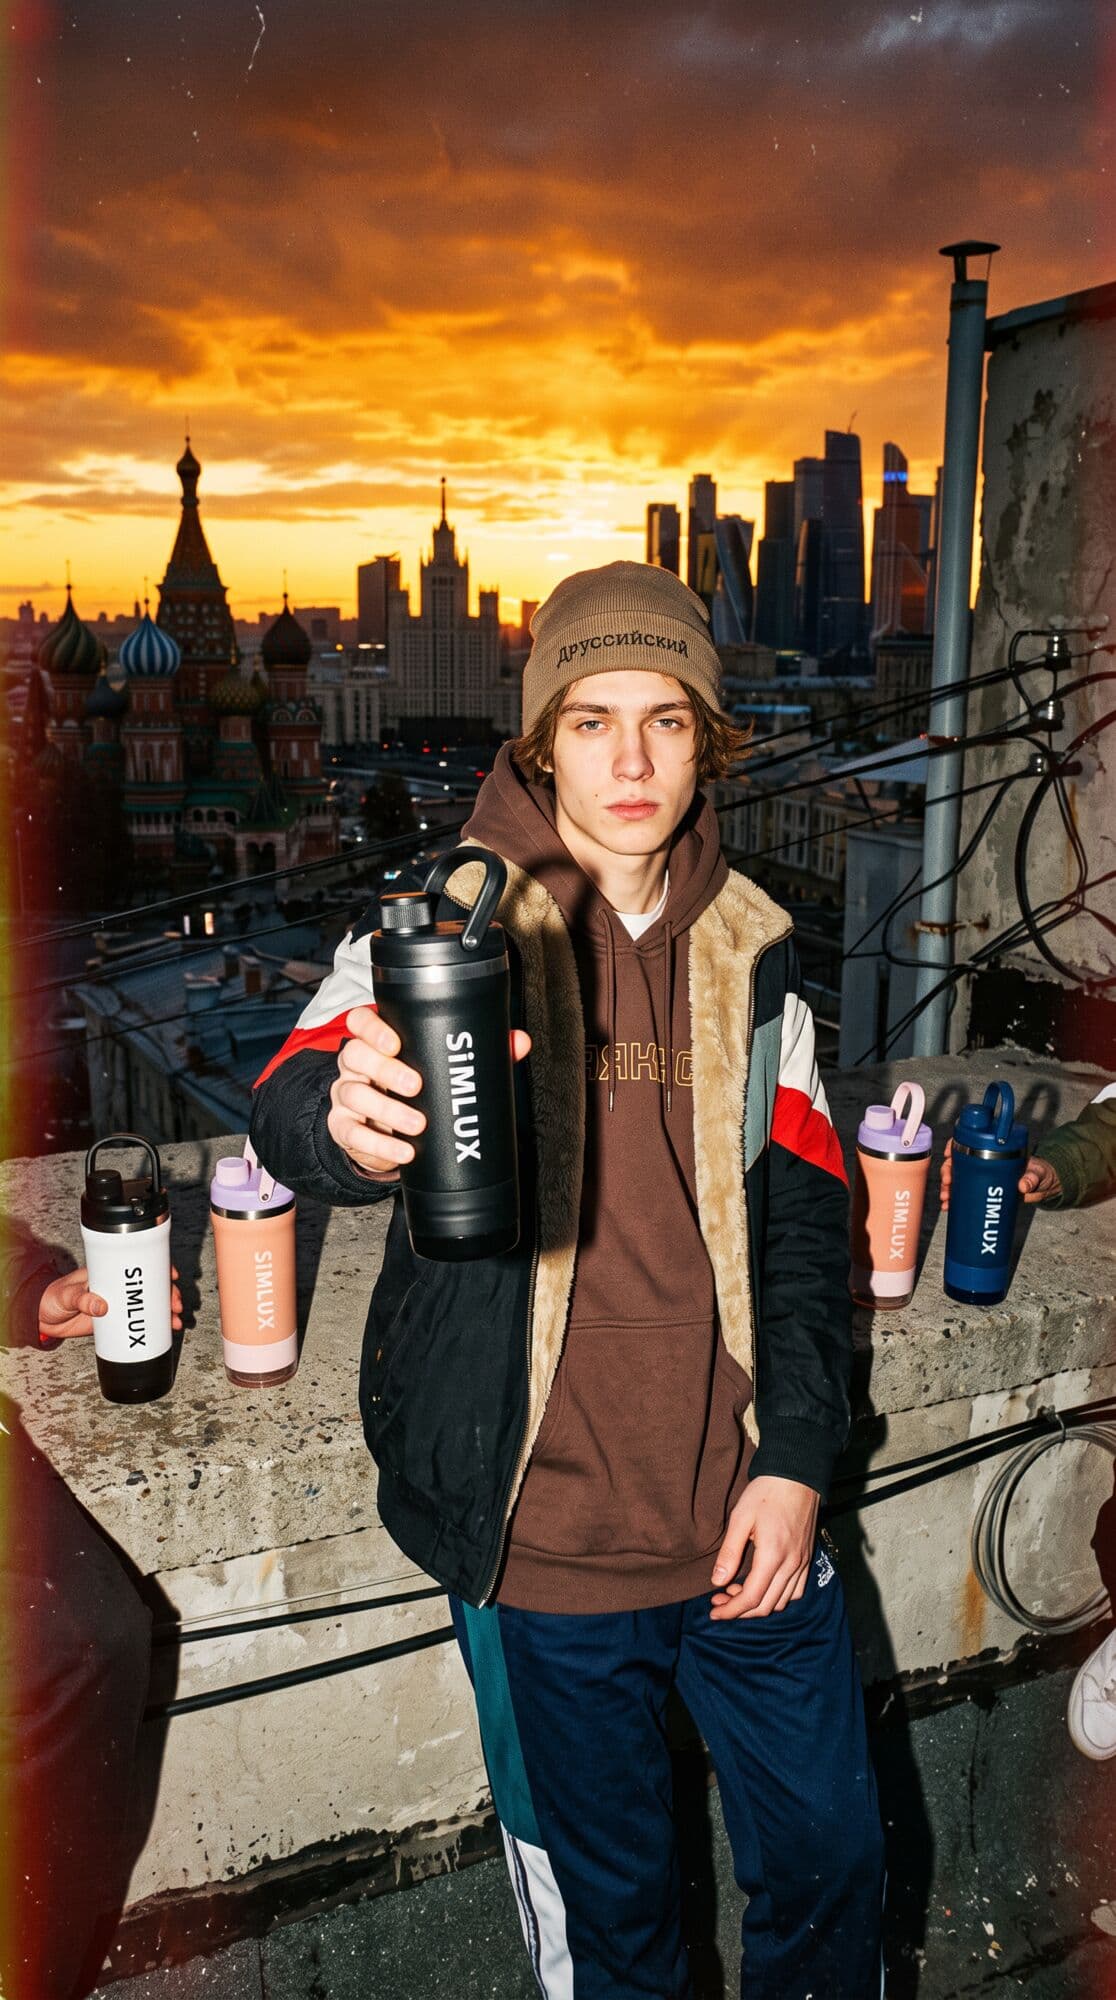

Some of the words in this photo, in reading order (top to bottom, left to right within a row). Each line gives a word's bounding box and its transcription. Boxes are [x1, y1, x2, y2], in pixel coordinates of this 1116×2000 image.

[445, 1031, 482, 1164] SiMLUX
[889, 1190, 911, 1260] SiMLUX
[981, 1186, 1004, 1255] SiMLUX
[124, 1266, 146, 1349] SiMLUX
